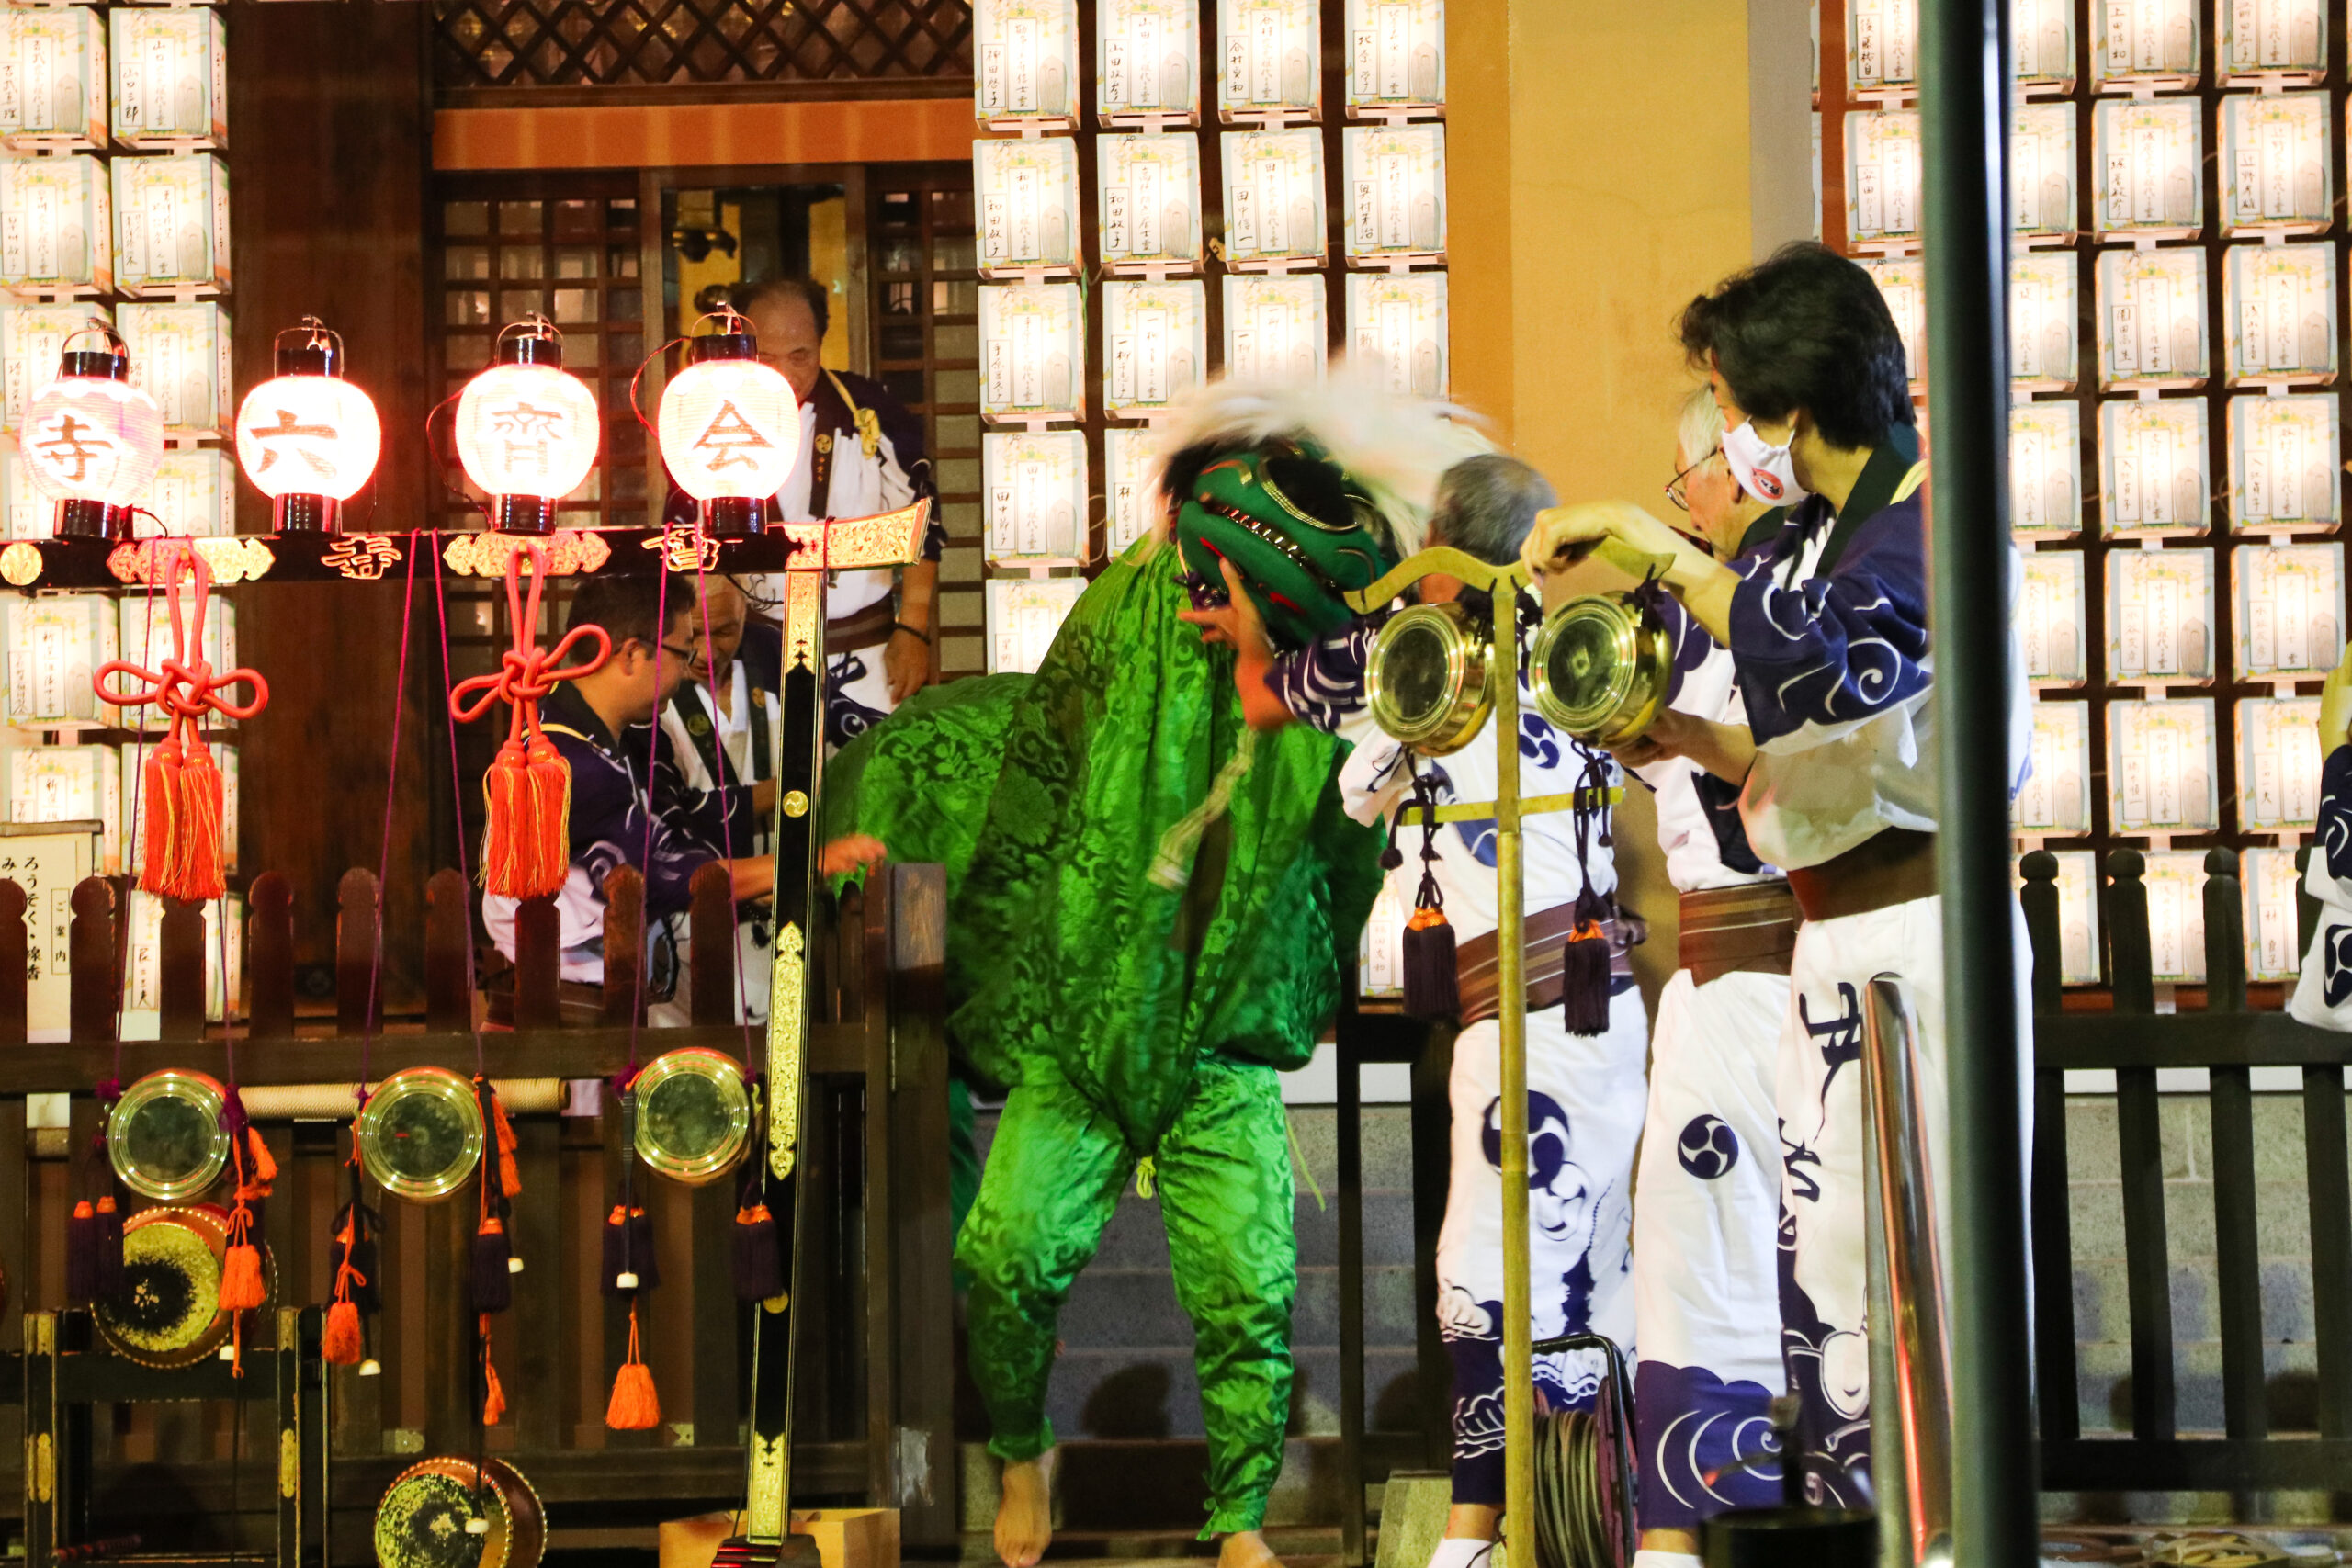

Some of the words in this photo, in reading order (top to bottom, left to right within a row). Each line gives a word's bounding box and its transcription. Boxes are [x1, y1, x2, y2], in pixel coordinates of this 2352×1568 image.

[122, 64, 141, 125] 山口三郎
[1108, 193, 1126, 250] 和田敏子
[1235, 189, 1256, 243] 田中信一
[34, 414, 114, 481] 寺
[249, 410, 338, 476] 六
[693, 400, 774, 472] 会
[1, 856, 17, 881] み
[24, 856, 42, 982] ろうそく・線香
[55, 900, 67, 964] ご案内
